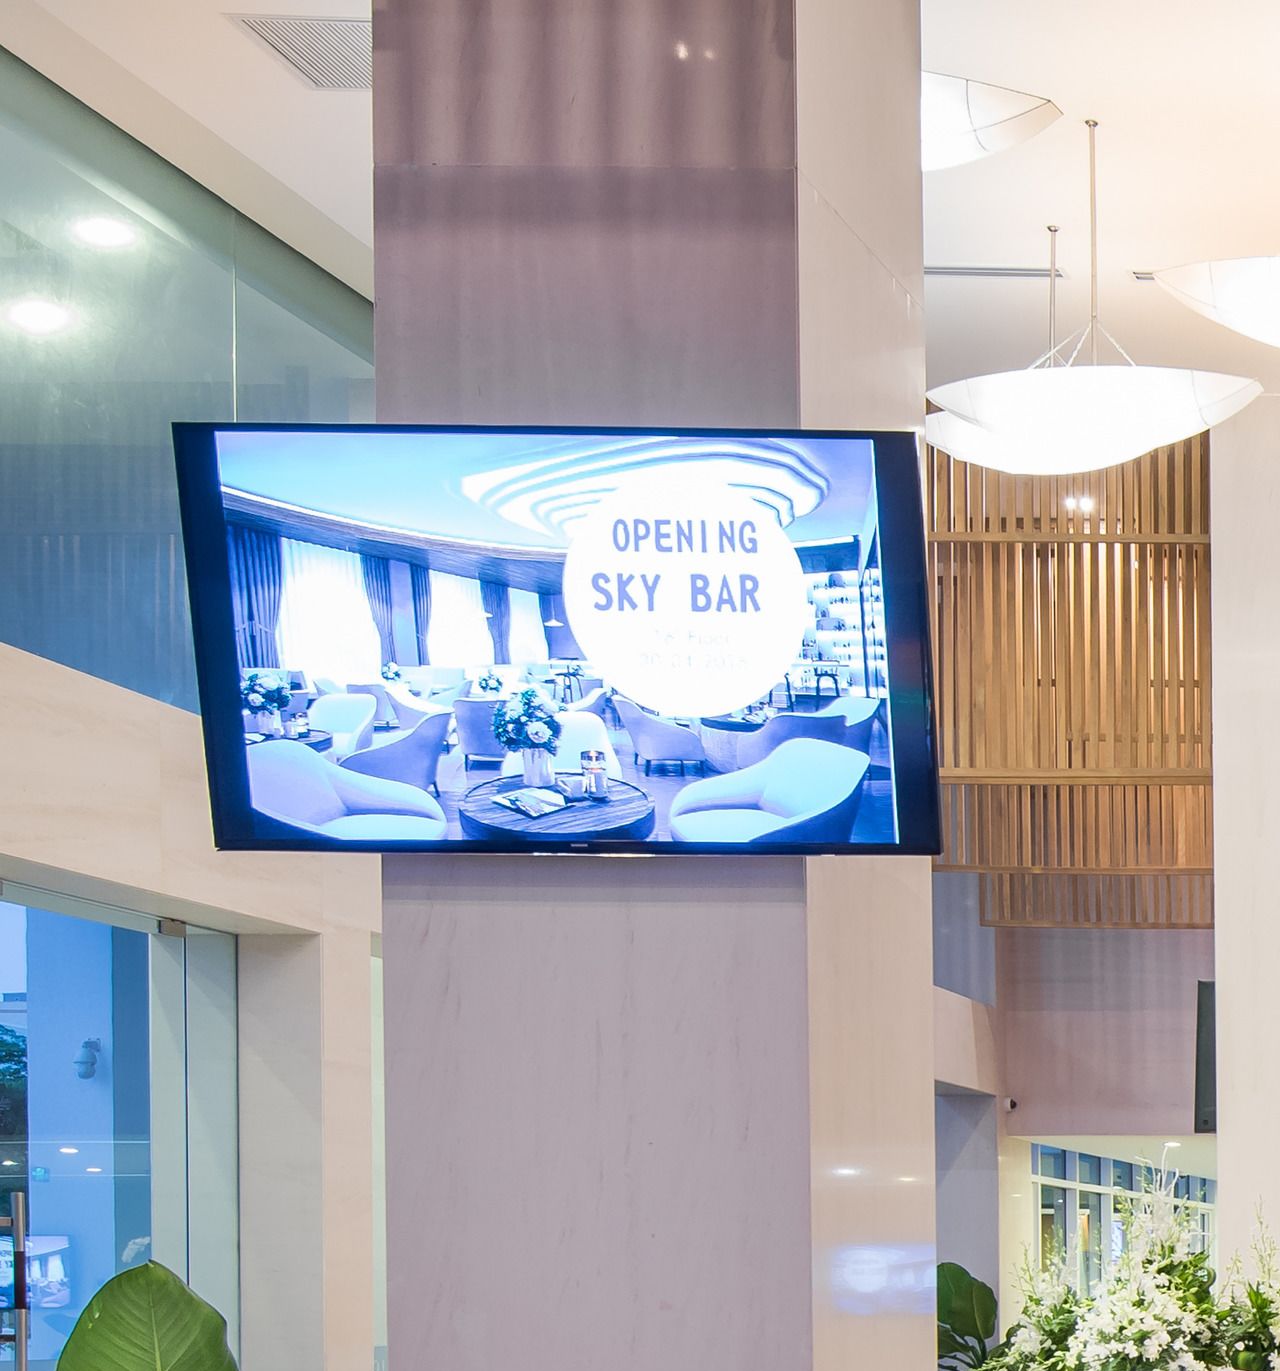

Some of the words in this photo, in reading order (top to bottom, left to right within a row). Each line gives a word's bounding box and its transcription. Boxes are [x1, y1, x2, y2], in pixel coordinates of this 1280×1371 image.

[612, 518, 758, 554] OPENING
[591, 572, 661, 612] SKY
[690, 573, 761, 613] BAR
